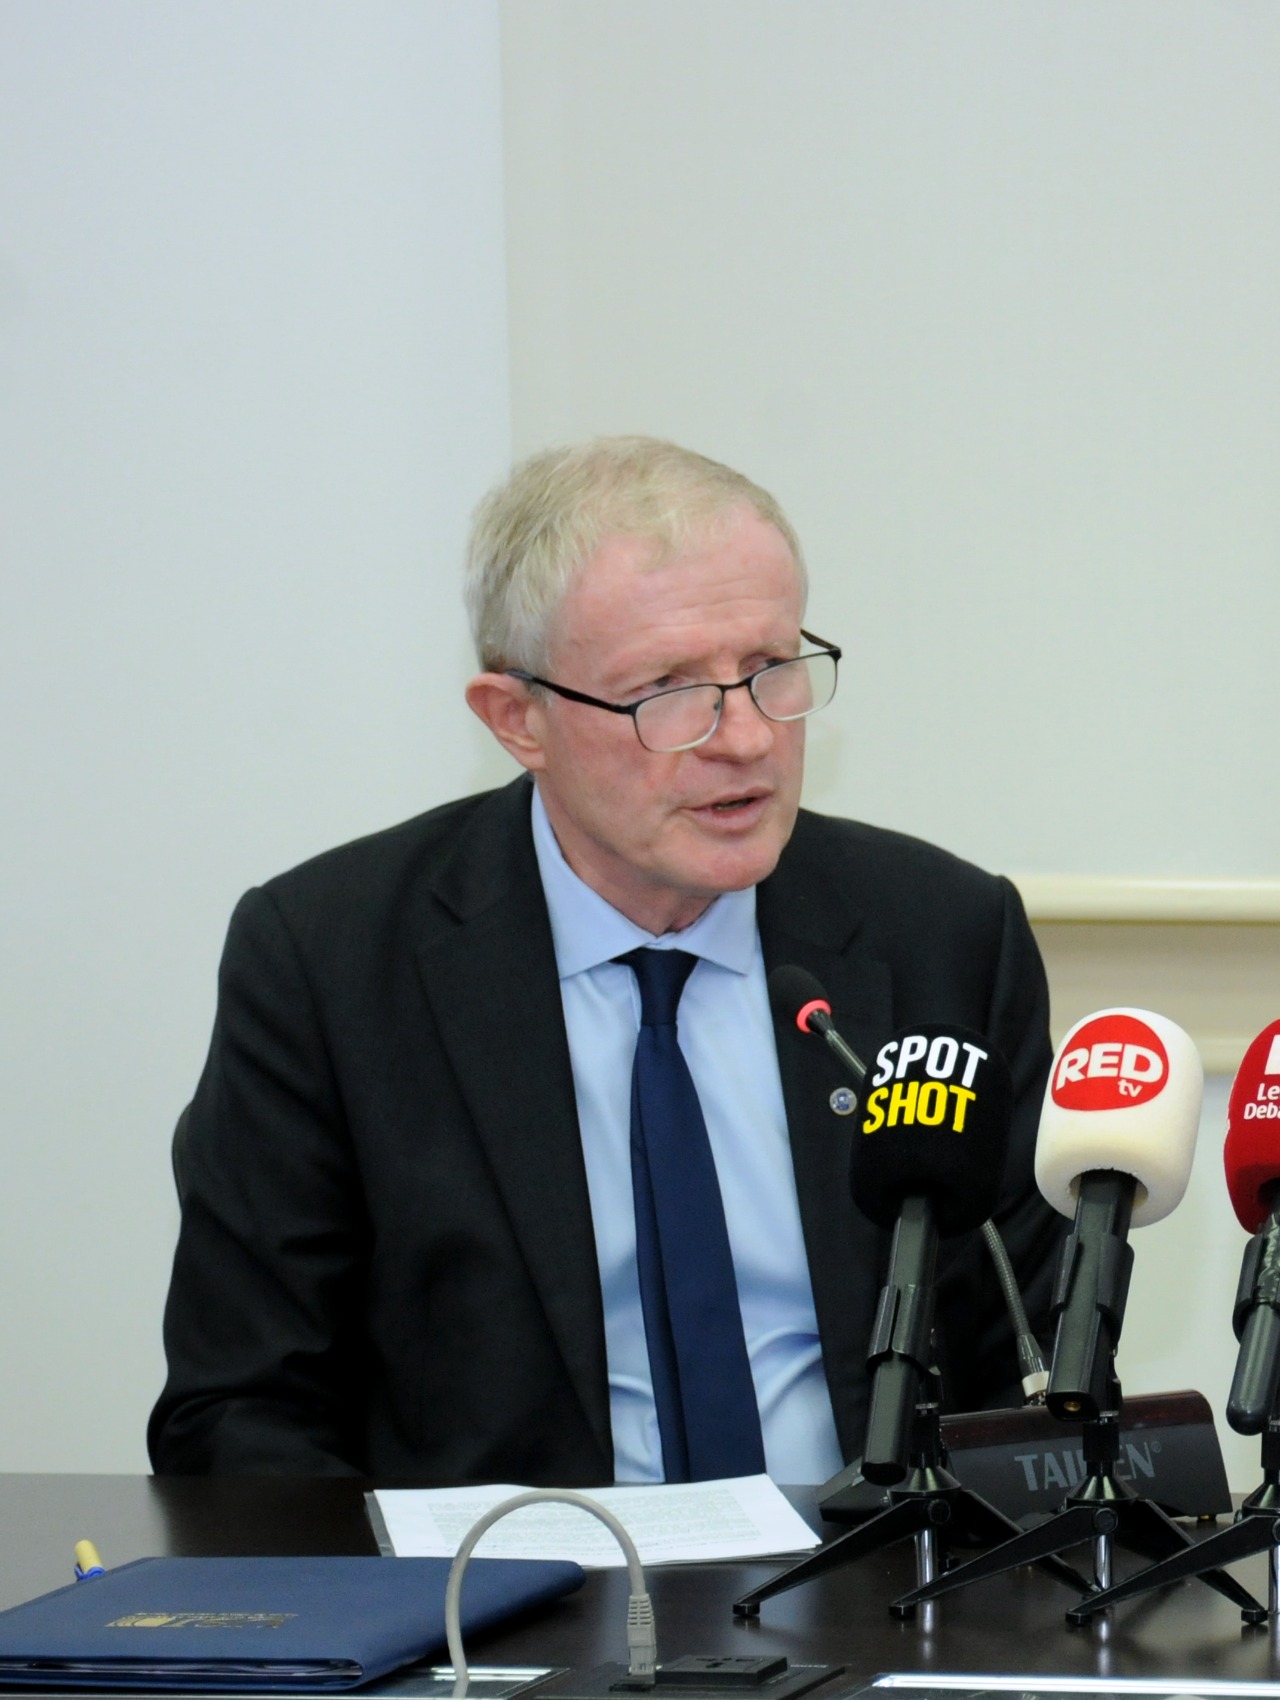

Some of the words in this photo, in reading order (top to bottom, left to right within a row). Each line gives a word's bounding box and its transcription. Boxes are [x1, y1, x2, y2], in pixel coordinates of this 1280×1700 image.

[872, 1035, 988, 1088] SPOT
[1056, 1043, 1163, 1091] RED
[863, 1081, 976, 1134] SHOT
[1118, 1079, 1143, 1098] tv
